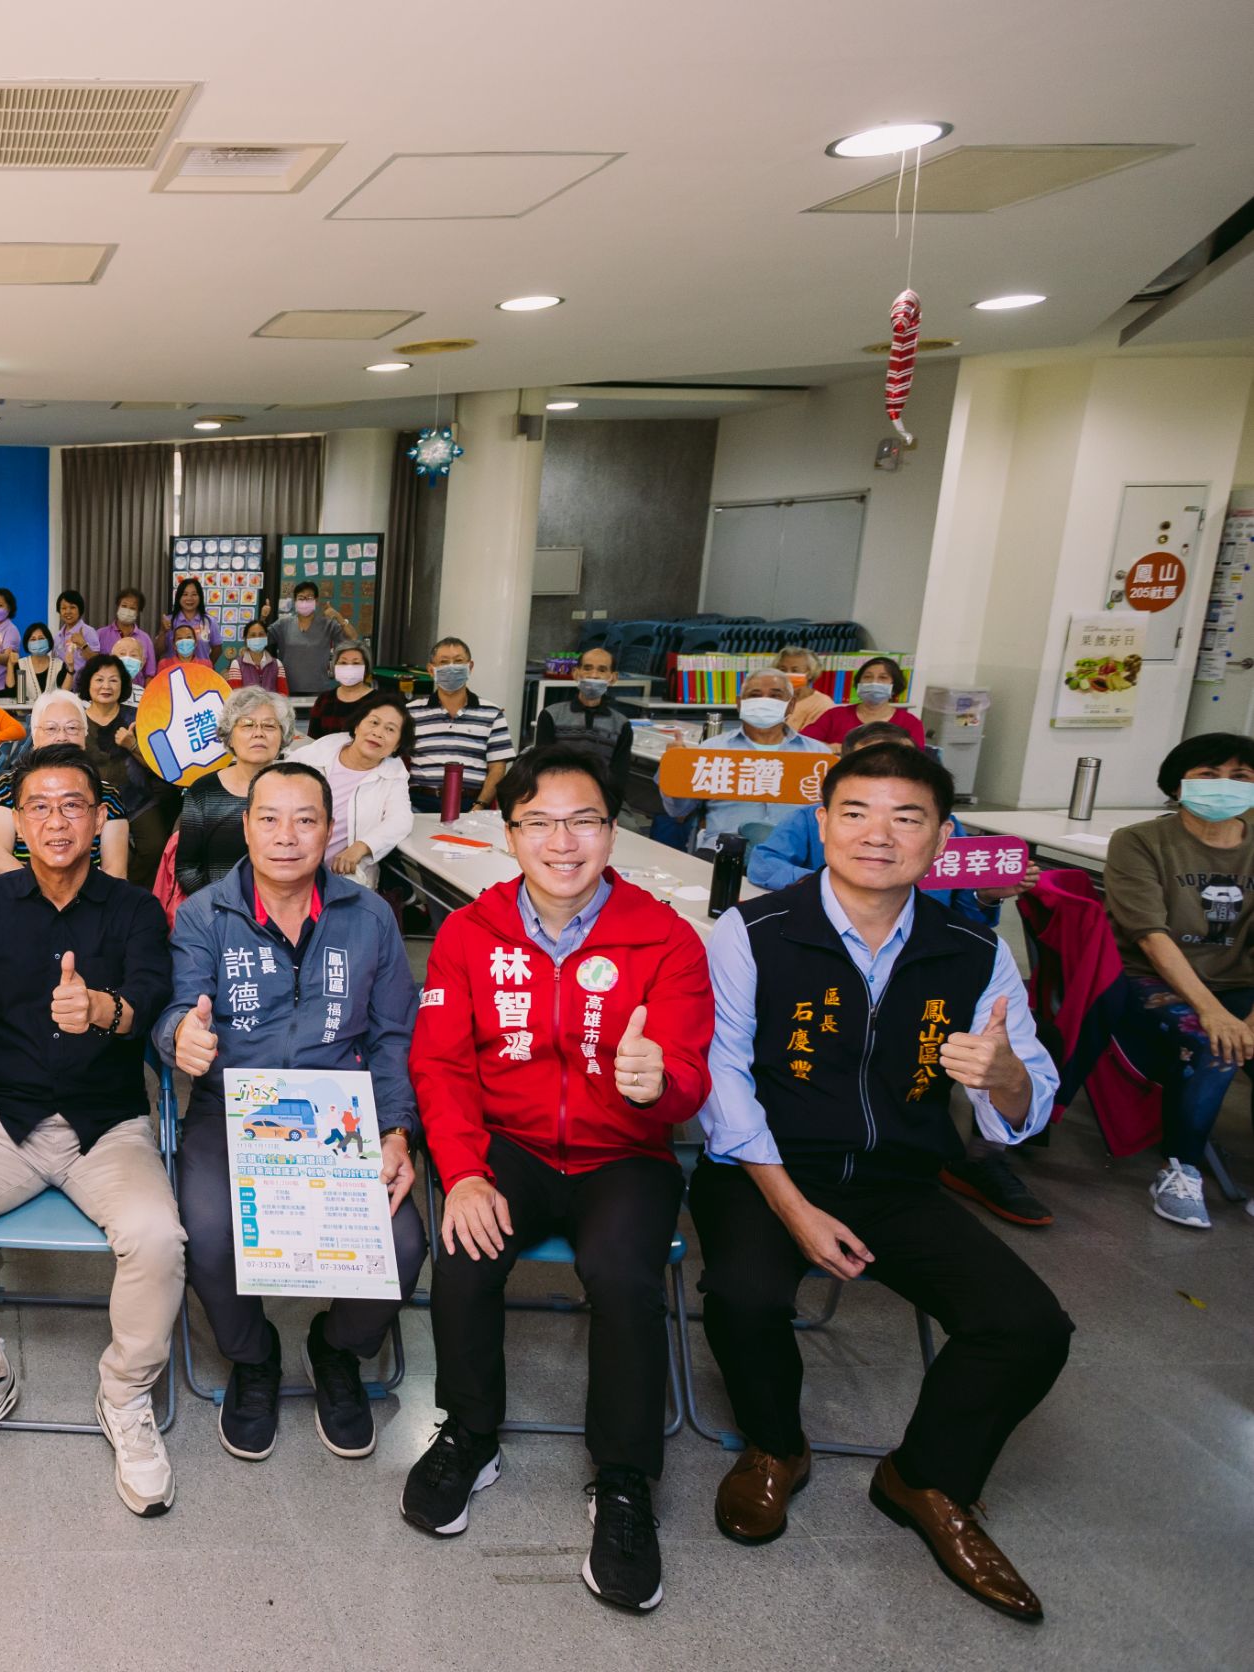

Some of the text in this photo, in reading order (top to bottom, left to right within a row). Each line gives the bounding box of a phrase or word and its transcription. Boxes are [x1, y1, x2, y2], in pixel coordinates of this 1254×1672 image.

[1129, 585, 1178, 600] 205社區
[1132, 563, 1179, 584] 鳳山
[691, 756, 784, 798] 雄讚
[924, 848, 1024, 878] 得幸福
[258, 946, 277, 974] 里長
[328, 951, 345, 993] 鳳山區
[321, 1002, 342, 1044] 福誠里
[489, 946, 533, 1062] 林智鴻
[819, 987, 842, 1034] 區長
[580, 994, 605, 1076] 高雄市議員
